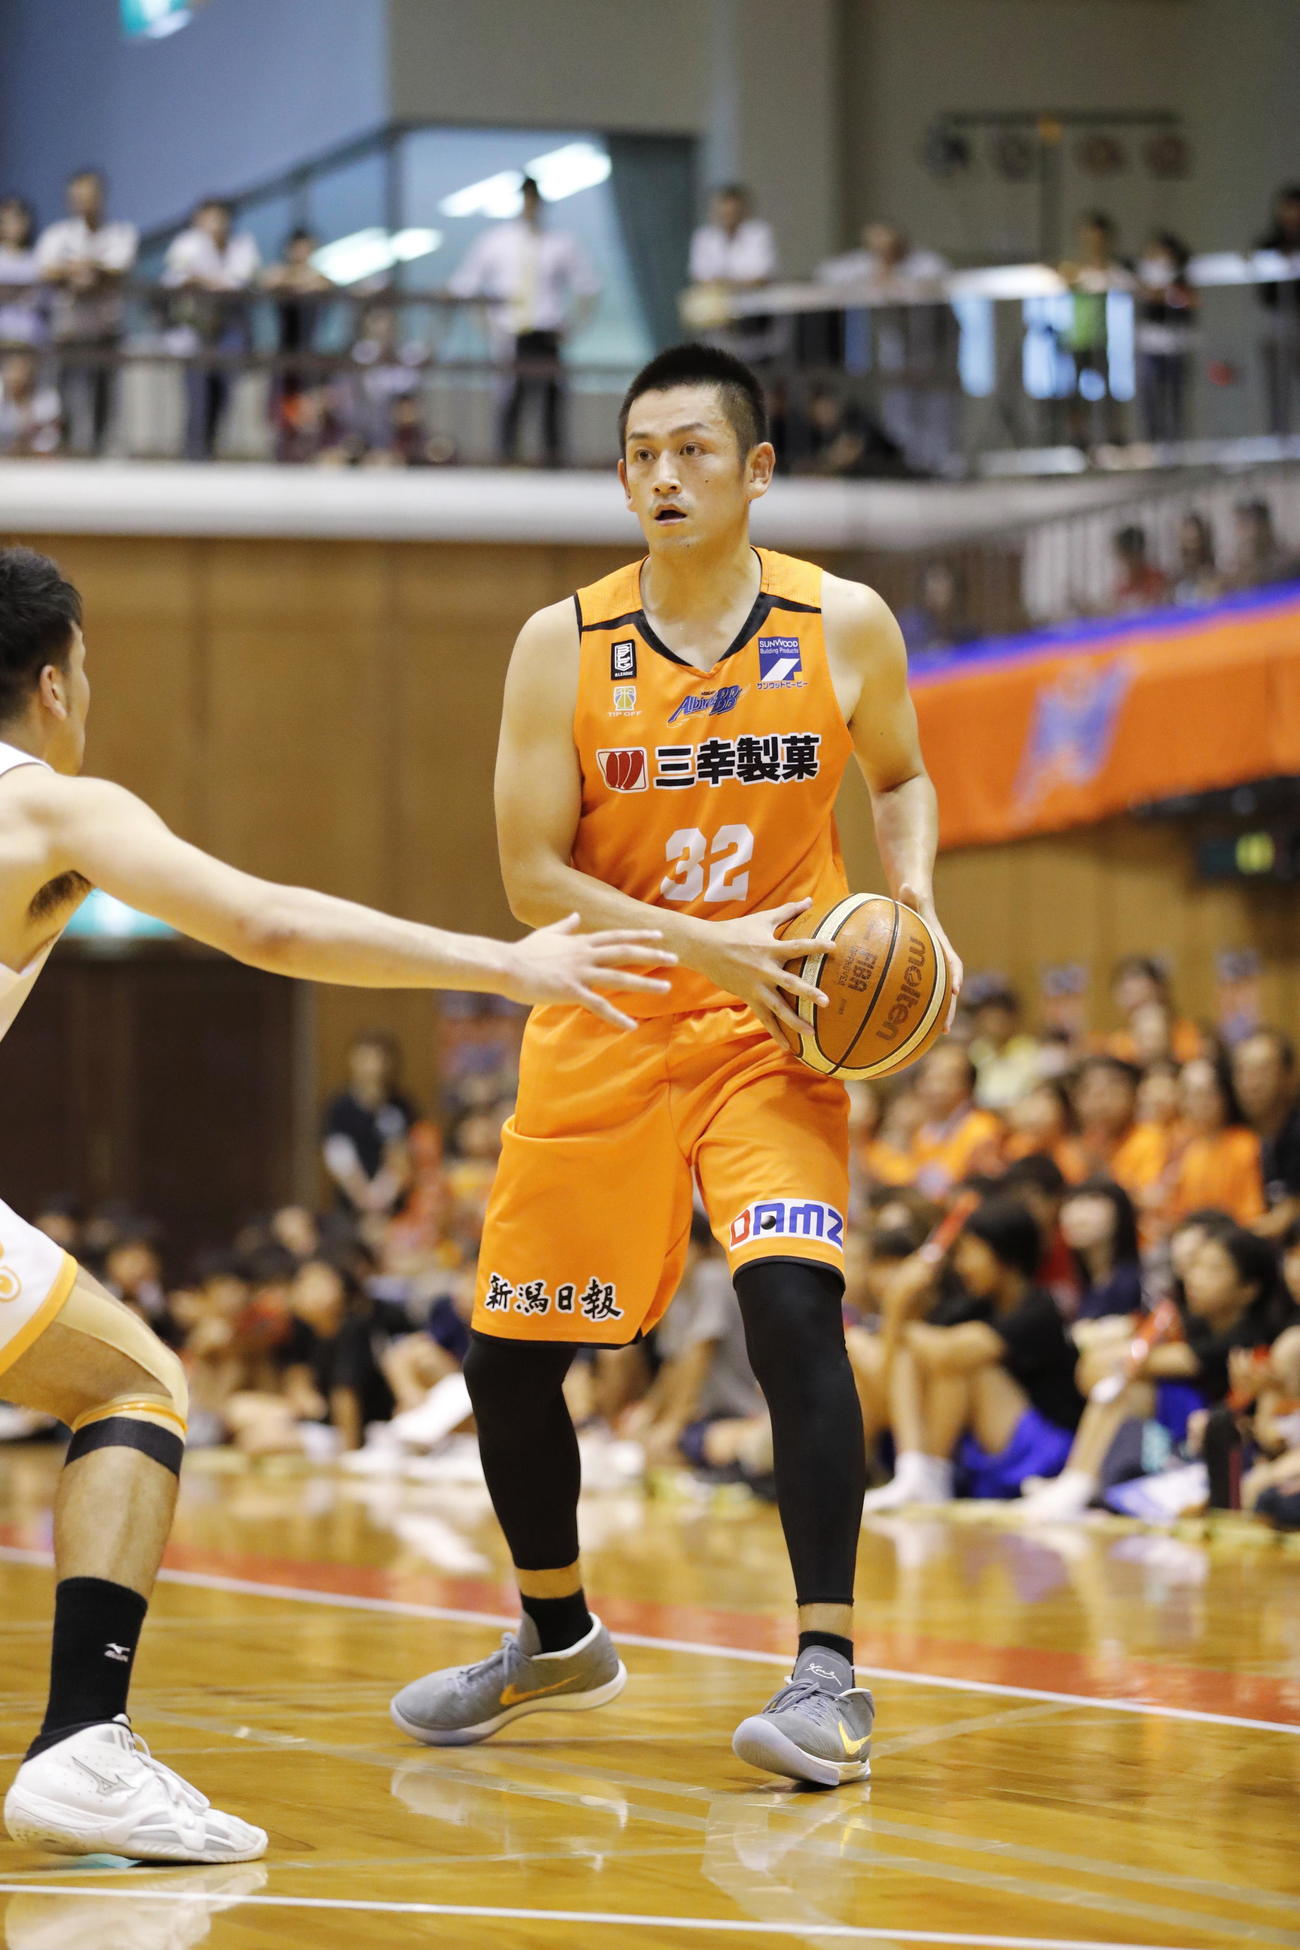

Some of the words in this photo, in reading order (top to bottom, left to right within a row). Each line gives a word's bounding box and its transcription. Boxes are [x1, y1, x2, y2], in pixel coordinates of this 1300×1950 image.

[760, 638, 798, 648] SUNWOOD
[655, 735, 820, 787] 三幸製菓
[660, 824, 754, 901] 32
[848, 950, 877, 992] FIBA
[876, 936, 926, 1040] molten
[486, 1275, 621, 1319] 新潟日報
